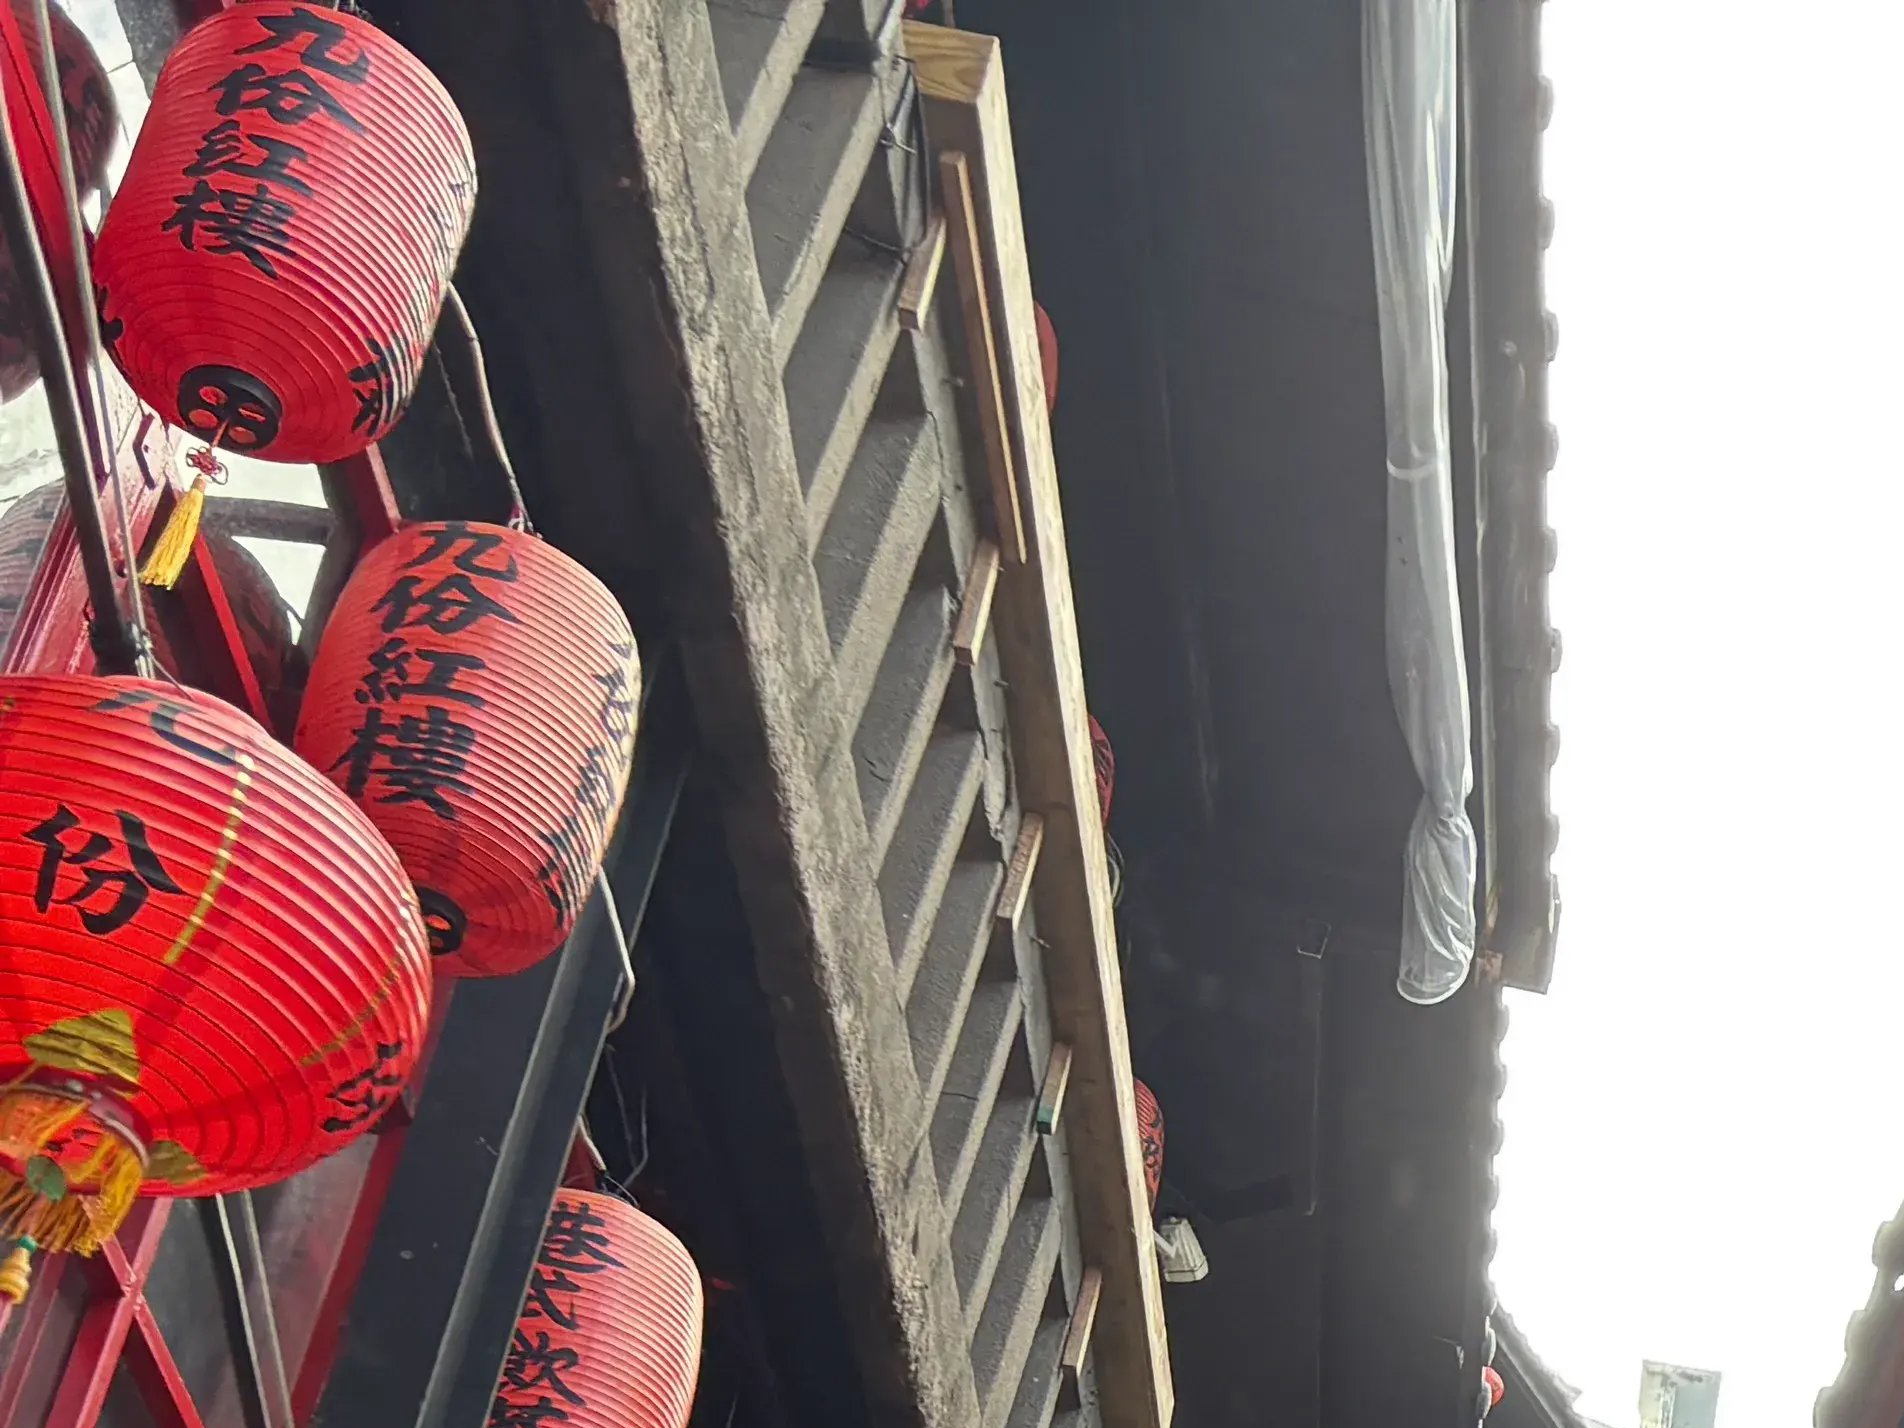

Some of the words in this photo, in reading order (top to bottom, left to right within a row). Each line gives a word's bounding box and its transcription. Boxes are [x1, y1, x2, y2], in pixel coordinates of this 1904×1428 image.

[162, 7, 370, 280] 九份紅樓
[330, 528, 525, 824] 九份紅樓
